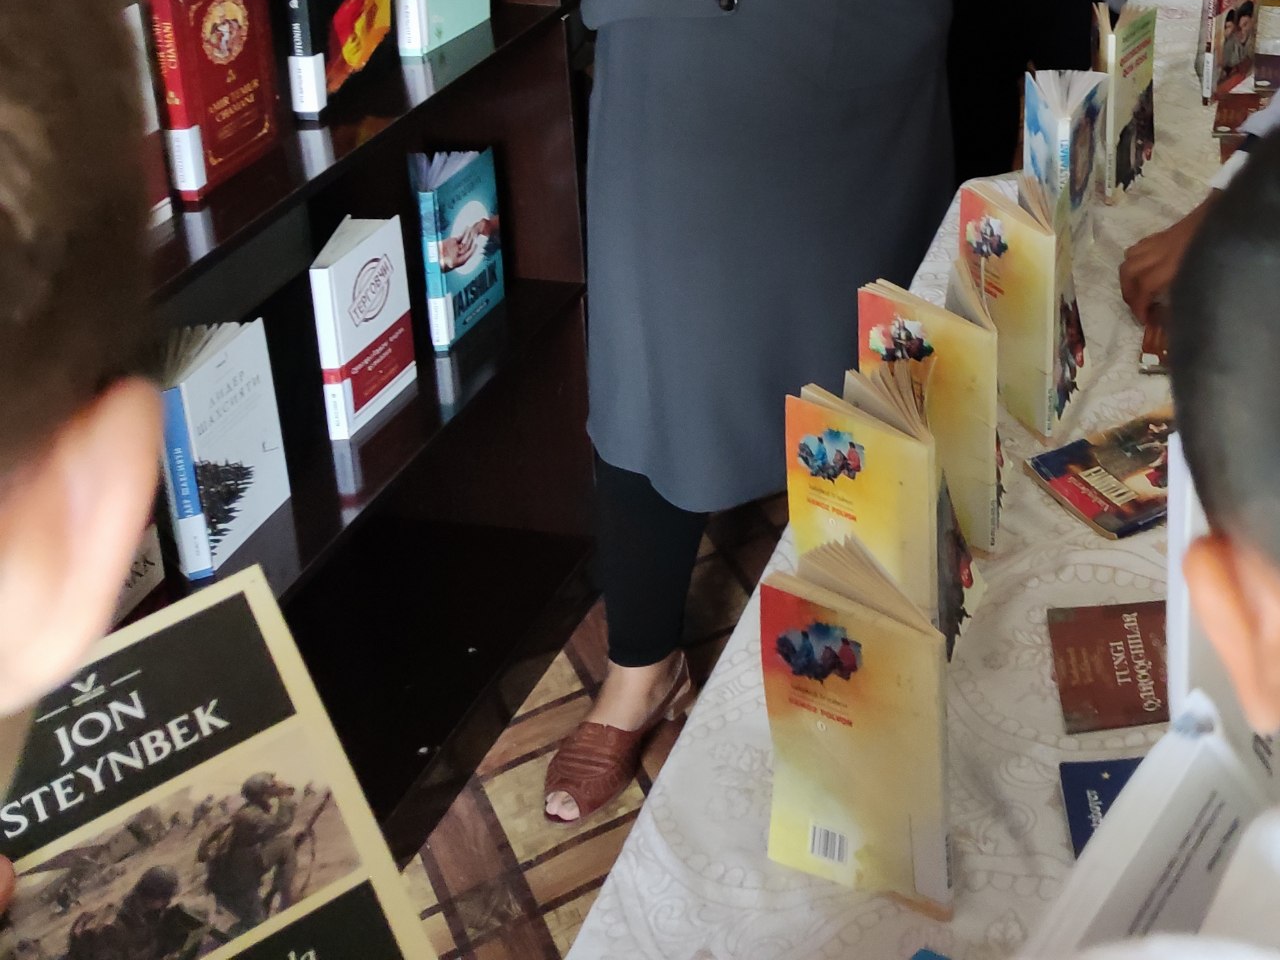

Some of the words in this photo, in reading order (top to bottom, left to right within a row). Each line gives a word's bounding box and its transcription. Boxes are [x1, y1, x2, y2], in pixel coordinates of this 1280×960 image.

[1109, 641, 1132, 686] TUNGI
[1122, 612, 1162, 712] QAROQCHILAR
[1, 699, 230, 840] STEYNBEK
[53, 691, 148, 767] JON
